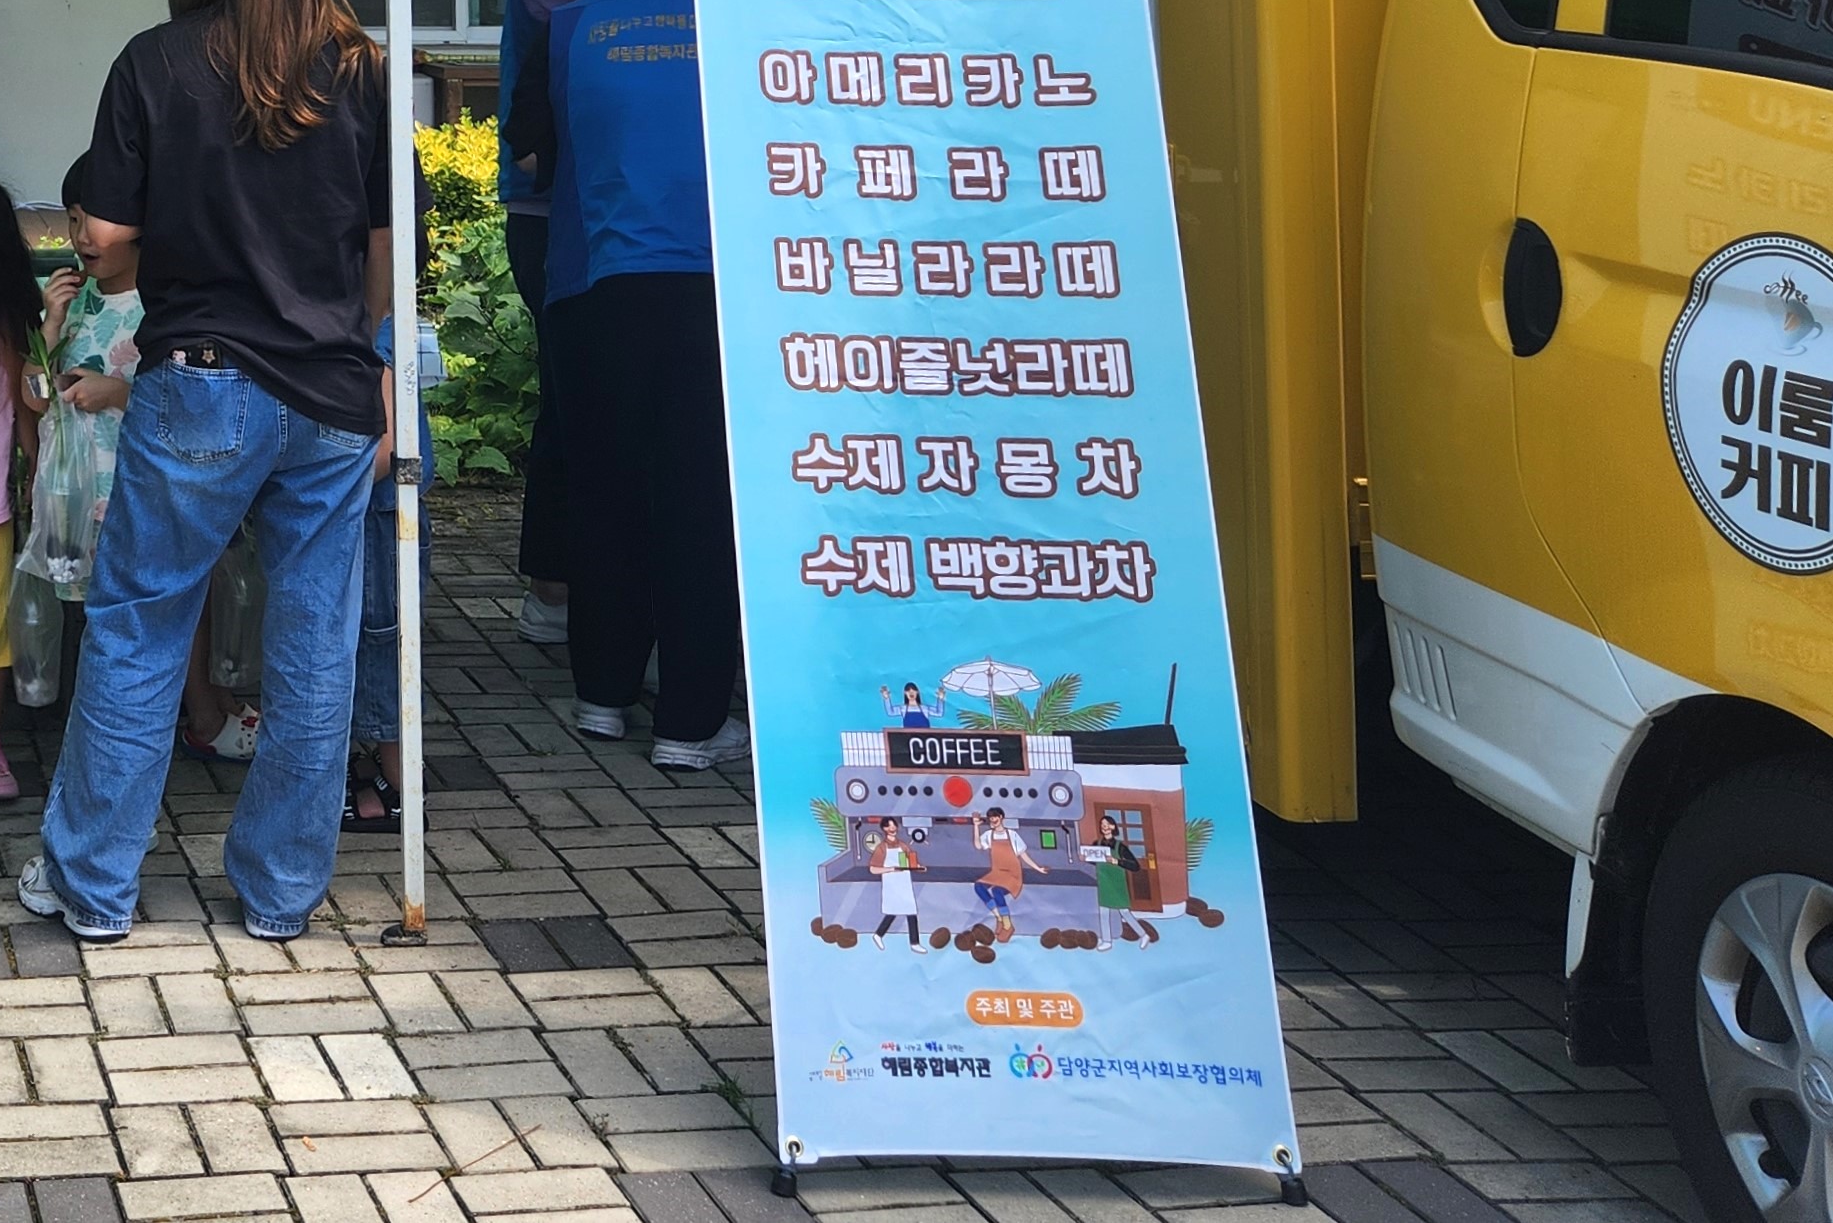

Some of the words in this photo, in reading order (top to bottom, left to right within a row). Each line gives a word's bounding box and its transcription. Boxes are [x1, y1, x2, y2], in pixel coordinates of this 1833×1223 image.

[758, 50, 1097, 108] 아메리카노
[774, 237, 1120, 298] 바닐라라떼
[779, 333, 1135, 398] 헤이즐넛라떼
[1722, 359, 1833, 449] 이룸
[792, 433, 905, 494] 수제
[1720, 434, 1831, 533] 커피
[801, 534, 915, 598] 수제
[928, 536, 1158, 603] 백향과차
[908, 737, 1002, 766] COFFEE
[1083, 848, 1108, 859] OPEN
[975, 996, 1011, 1019] 주최
[1016, 997, 1035, 1020] 및
[1039, 998, 1075, 1020] 주관
[880, 1056, 992, 1078] 해림종합복지관
[1056, 1056, 1264, 1088] 담양군지역사회보장협의체
